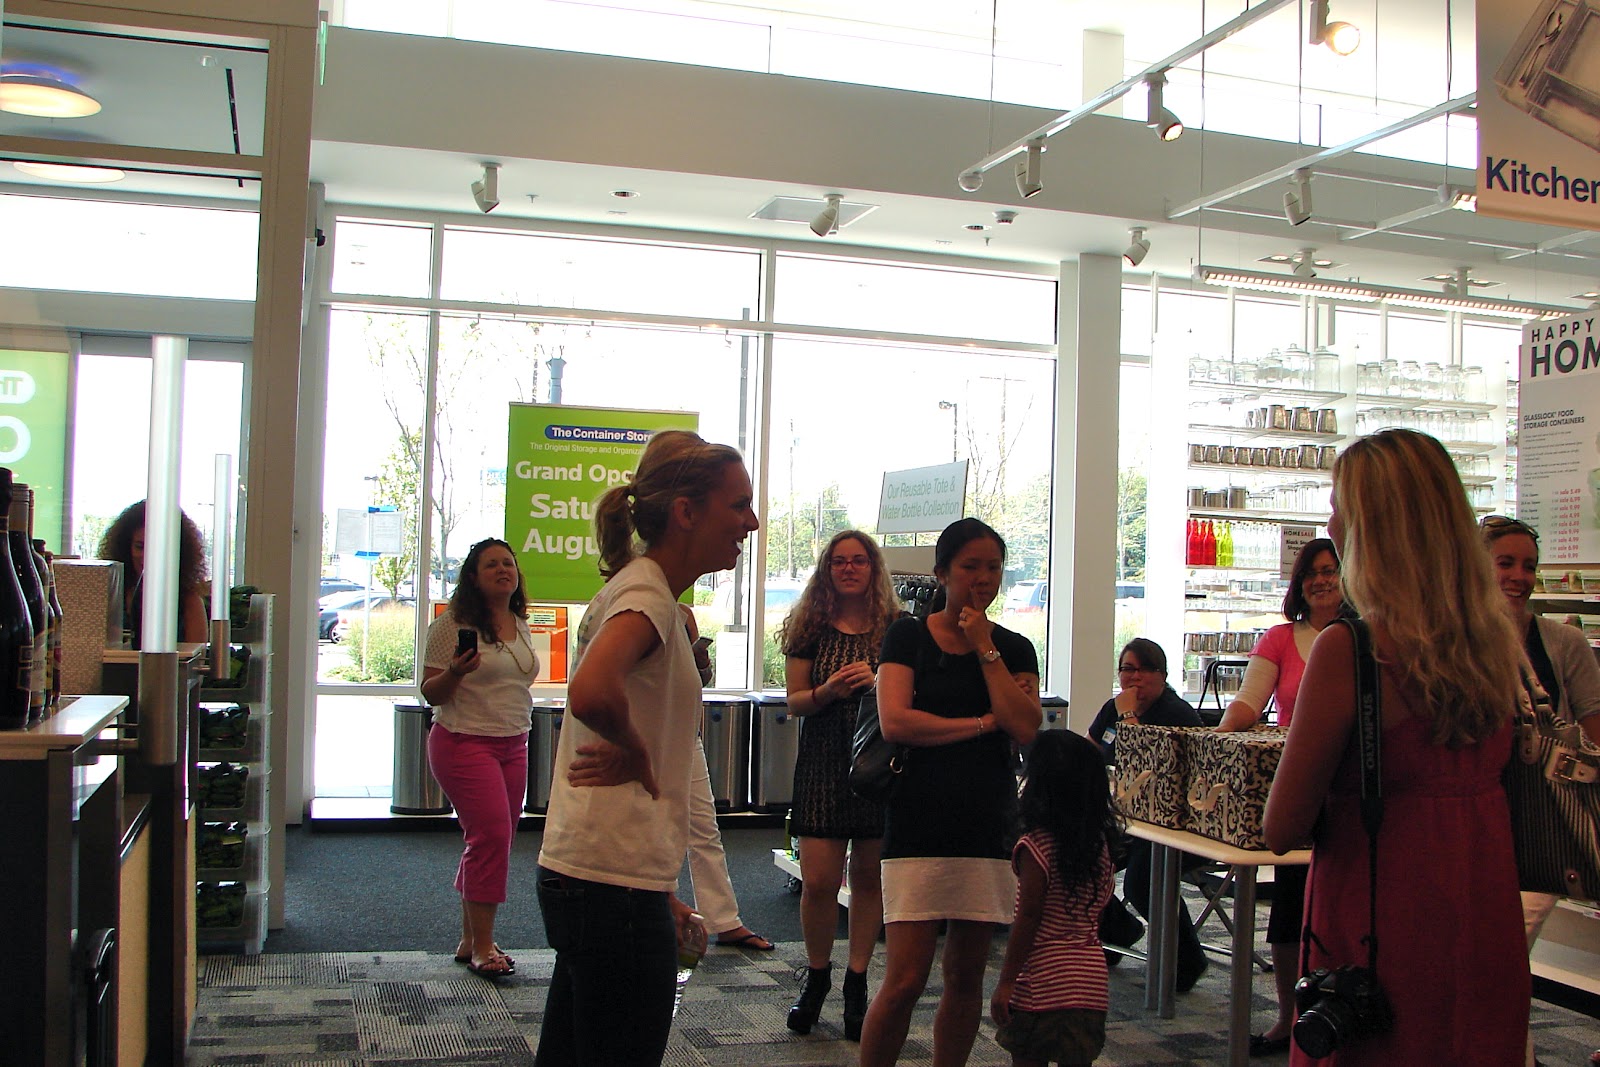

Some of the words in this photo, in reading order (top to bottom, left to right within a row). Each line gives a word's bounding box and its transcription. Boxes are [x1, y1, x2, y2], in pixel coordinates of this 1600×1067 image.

[1531, 318, 1595, 343] HAPPY
[1523, 420, 1548, 429] STORAGE
[1550, 416, 1585, 427] CONTAINERS
[552, 427, 572, 438] The
[573, 428, 625, 440] Container
[530, 442, 543, 450] The
[544, 443, 570, 452] Original
[572, 444, 598, 454] Storage
[515, 461, 583, 481] Grand
[887, 483, 900, 500] Our
[900, 480, 932, 498] Reusable
[934, 477, 949, 494] Tote
[902, 502, 922, 518] Bottle
[923, 499, 960, 517] Collection
[1362, 693, 1375, 769] OLYMPUS
